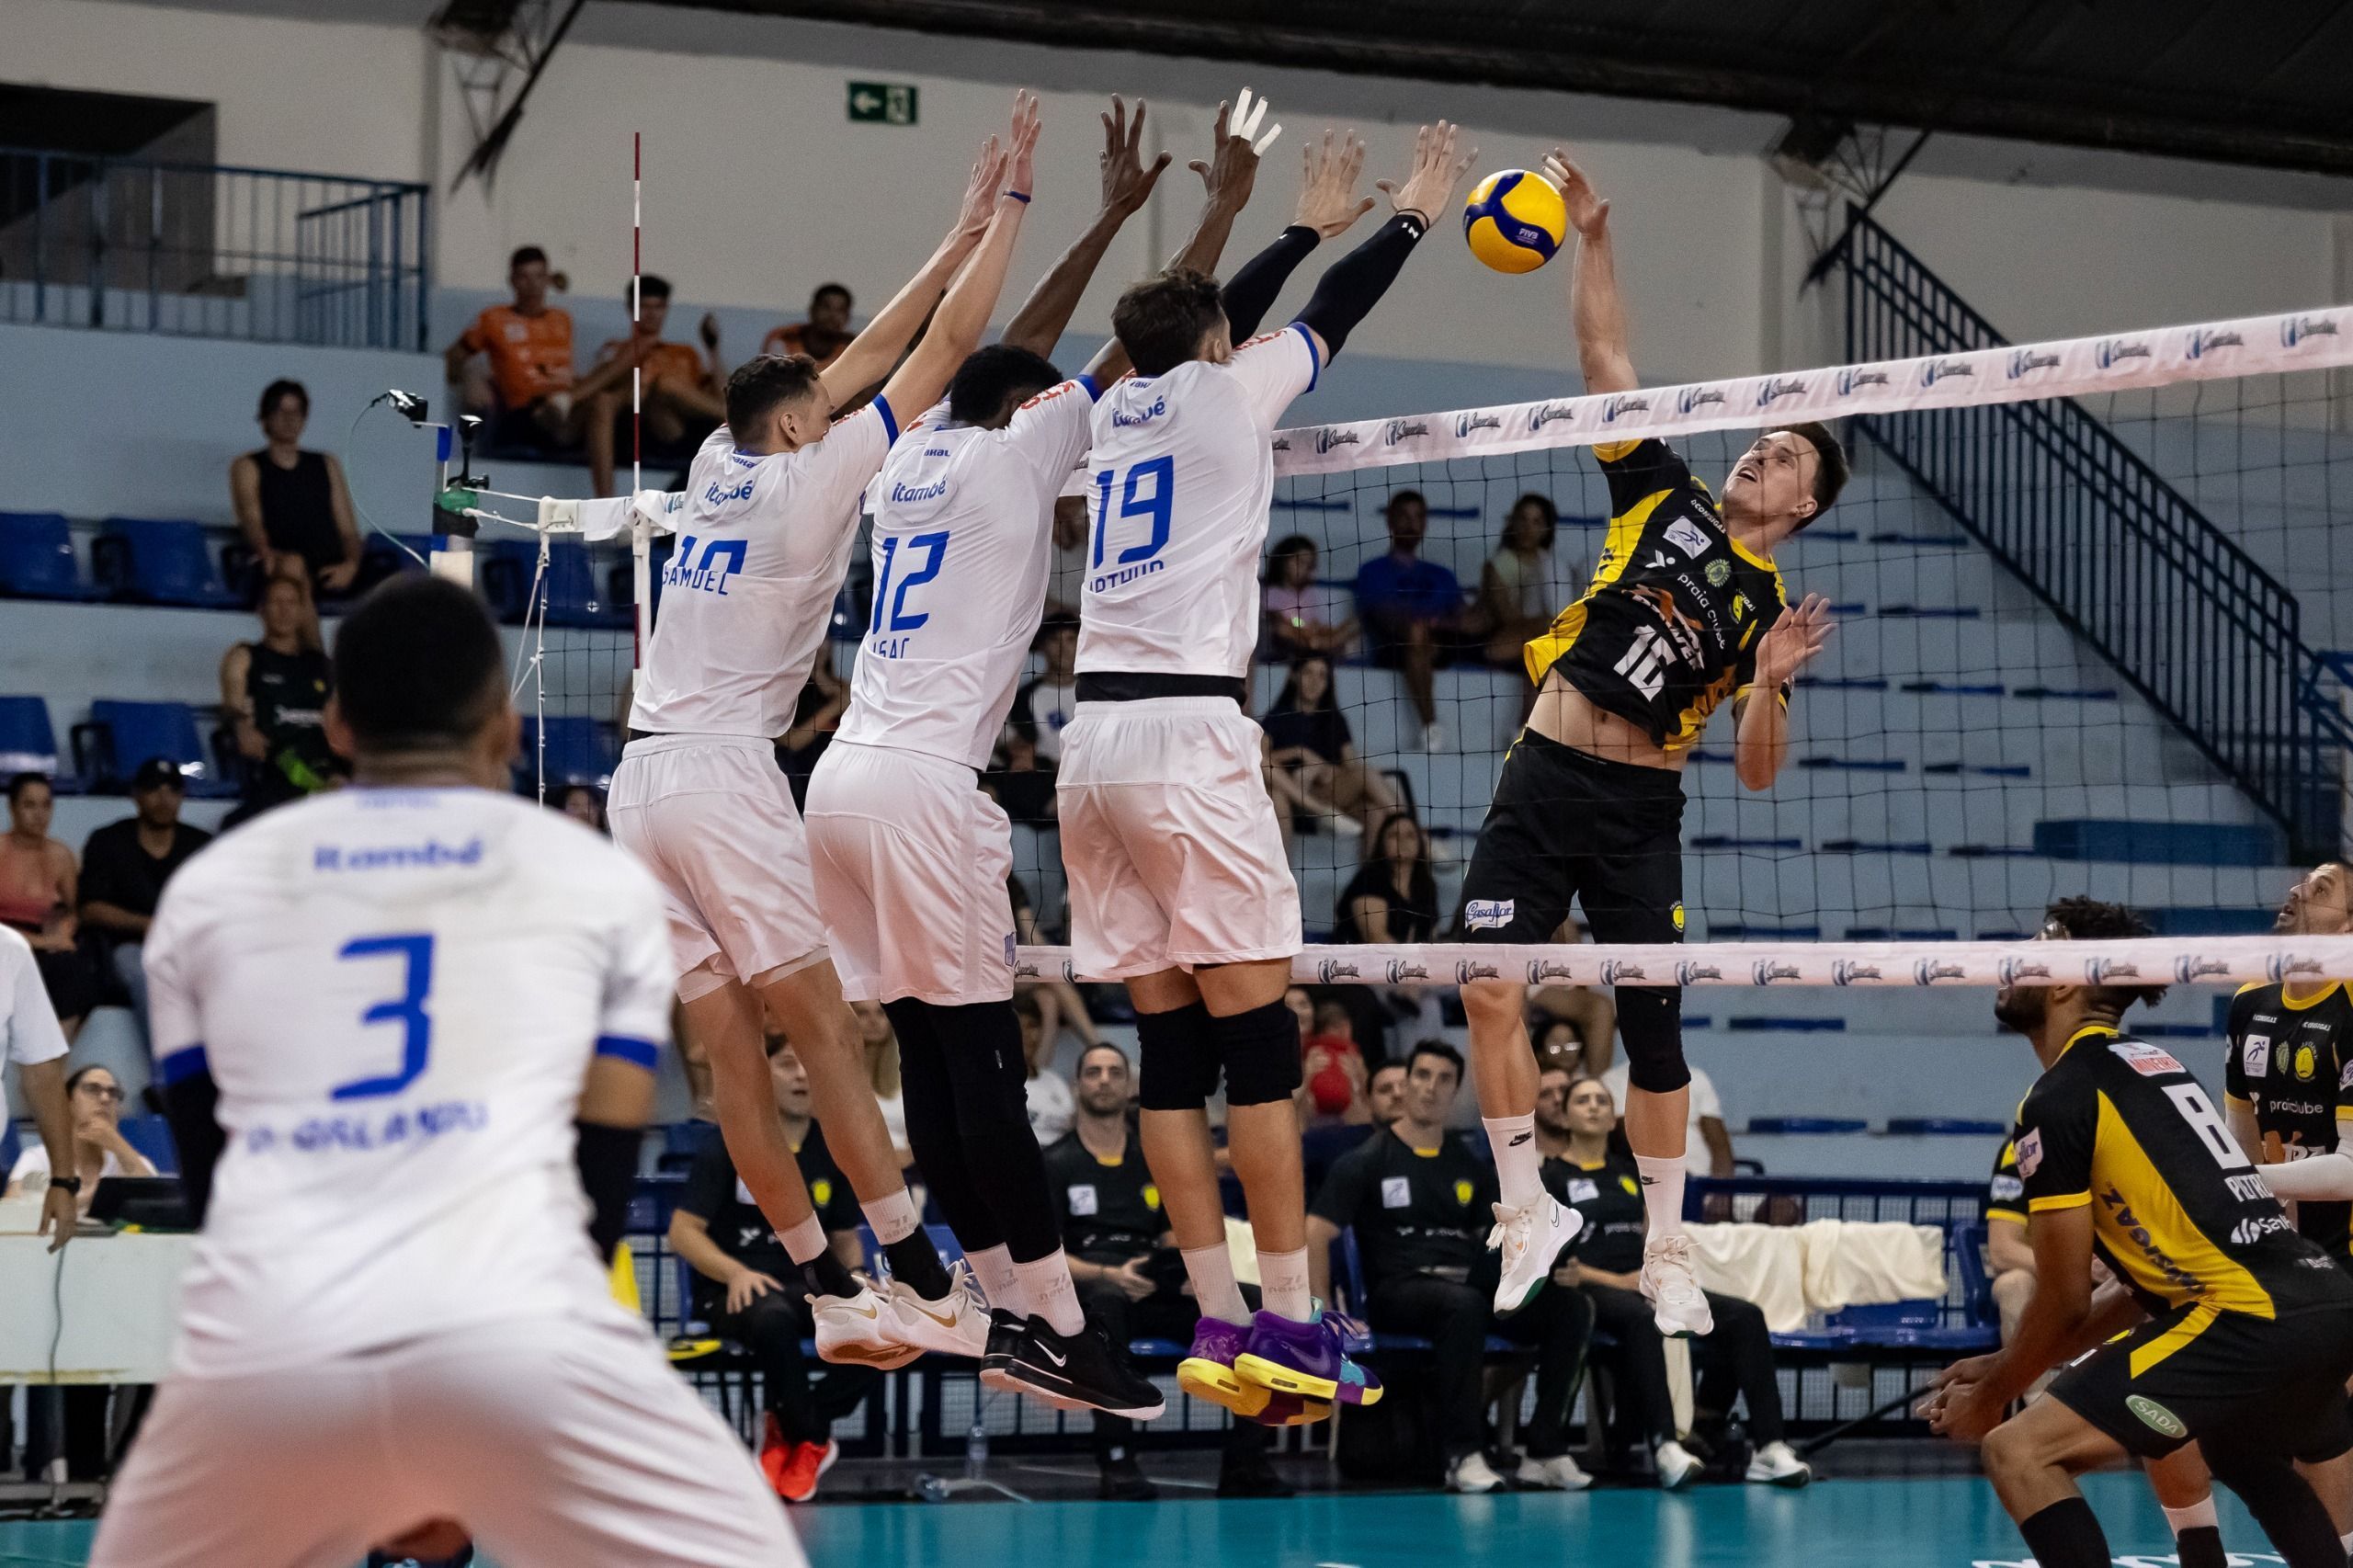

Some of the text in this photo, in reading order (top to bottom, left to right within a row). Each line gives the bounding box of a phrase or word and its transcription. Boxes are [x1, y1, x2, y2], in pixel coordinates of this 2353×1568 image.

[1518, 228, 1539, 240] FIVB
[1093, 455, 1174, 570] 19
[662, 564, 729, 596] SAMUEL
[872, 530, 950, 635] 12
[1677, 573, 1710, 608] praia
[1613, 624, 1678, 702] 16
[1466, 901, 1513, 924] Casaflor
[330, 932, 436, 1101] 3
[2161, 1082, 2256, 1170] 8
[2135, 1401, 2179, 1435] SADA
